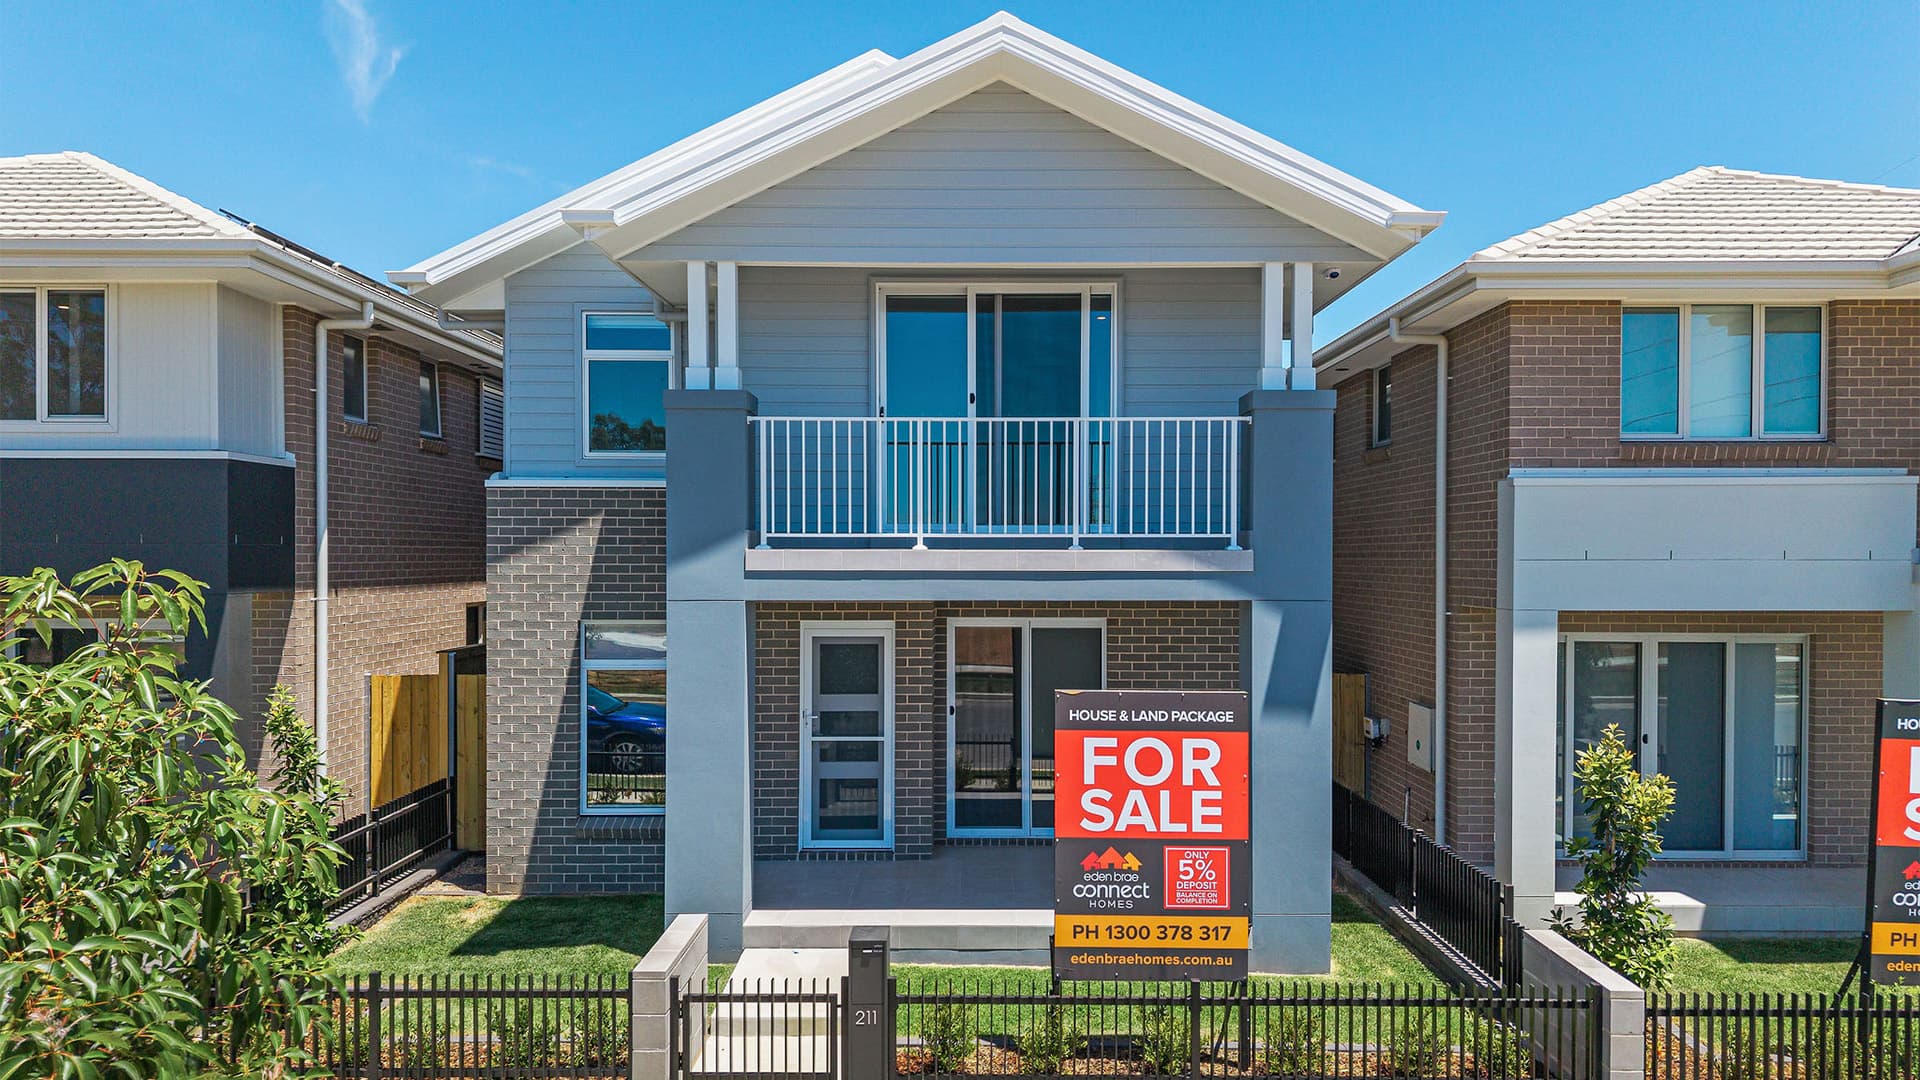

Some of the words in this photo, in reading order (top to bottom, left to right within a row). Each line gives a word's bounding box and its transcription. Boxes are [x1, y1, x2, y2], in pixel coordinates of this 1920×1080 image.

[1069, 709, 1117, 722] HOUSE
[1119, 710, 1129, 722] &
[1131, 710, 1169, 722] LAND
[1171, 710, 1234, 723] PACKAGE
[1083, 736, 1222, 786] FOR
[1079, 788, 1223, 833] SALE
[1184, 851, 1210, 859] ONLY
[1083, 871, 1112, 882] eden
[1113, 871, 1139, 882] brae
[1179, 859, 1216, 881] 5%
[1072, 882, 1150, 899] connect
[1176, 881, 1218, 890] DEPOSIT
[1089, 899, 1134, 909] HOMES
[1072, 925, 1099, 940] PH
[1105, 925, 1151, 941] 1300
[1156, 925, 1193, 941] 378
[1199, 925, 1232, 941] 317
[1890, 932, 1917, 947] PH
[1070, 953, 1233, 966] edenbraehomes.com.au
[855, 1010, 877, 1025] 211
